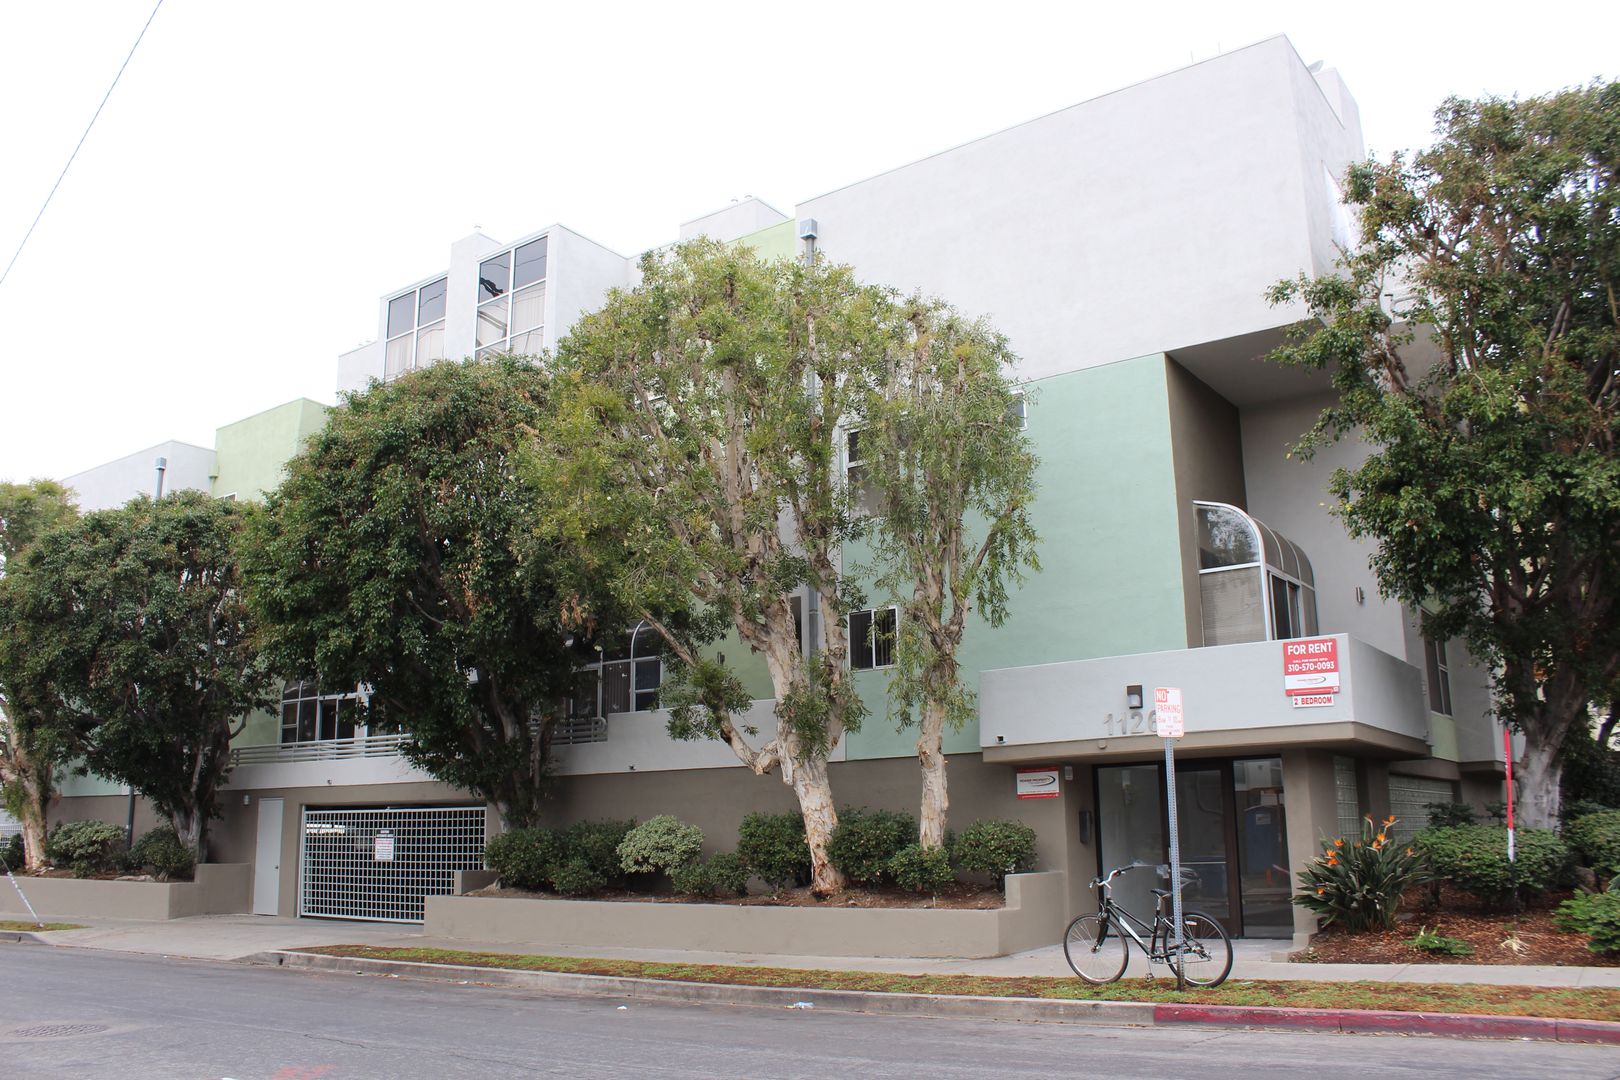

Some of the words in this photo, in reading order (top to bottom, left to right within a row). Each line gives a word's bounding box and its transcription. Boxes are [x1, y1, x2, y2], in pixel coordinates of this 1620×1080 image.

[1287, 644, 1306, 655] FOR
[1308, 642, 1333, 654] RENT
[1287, 661, 1335, 672] 310-570-0093
[1156, 690, 1167, 702] NO
[1301, 696, 1333, 705] BEDROOM
[1157, 704, 1181, 714] PARKING
